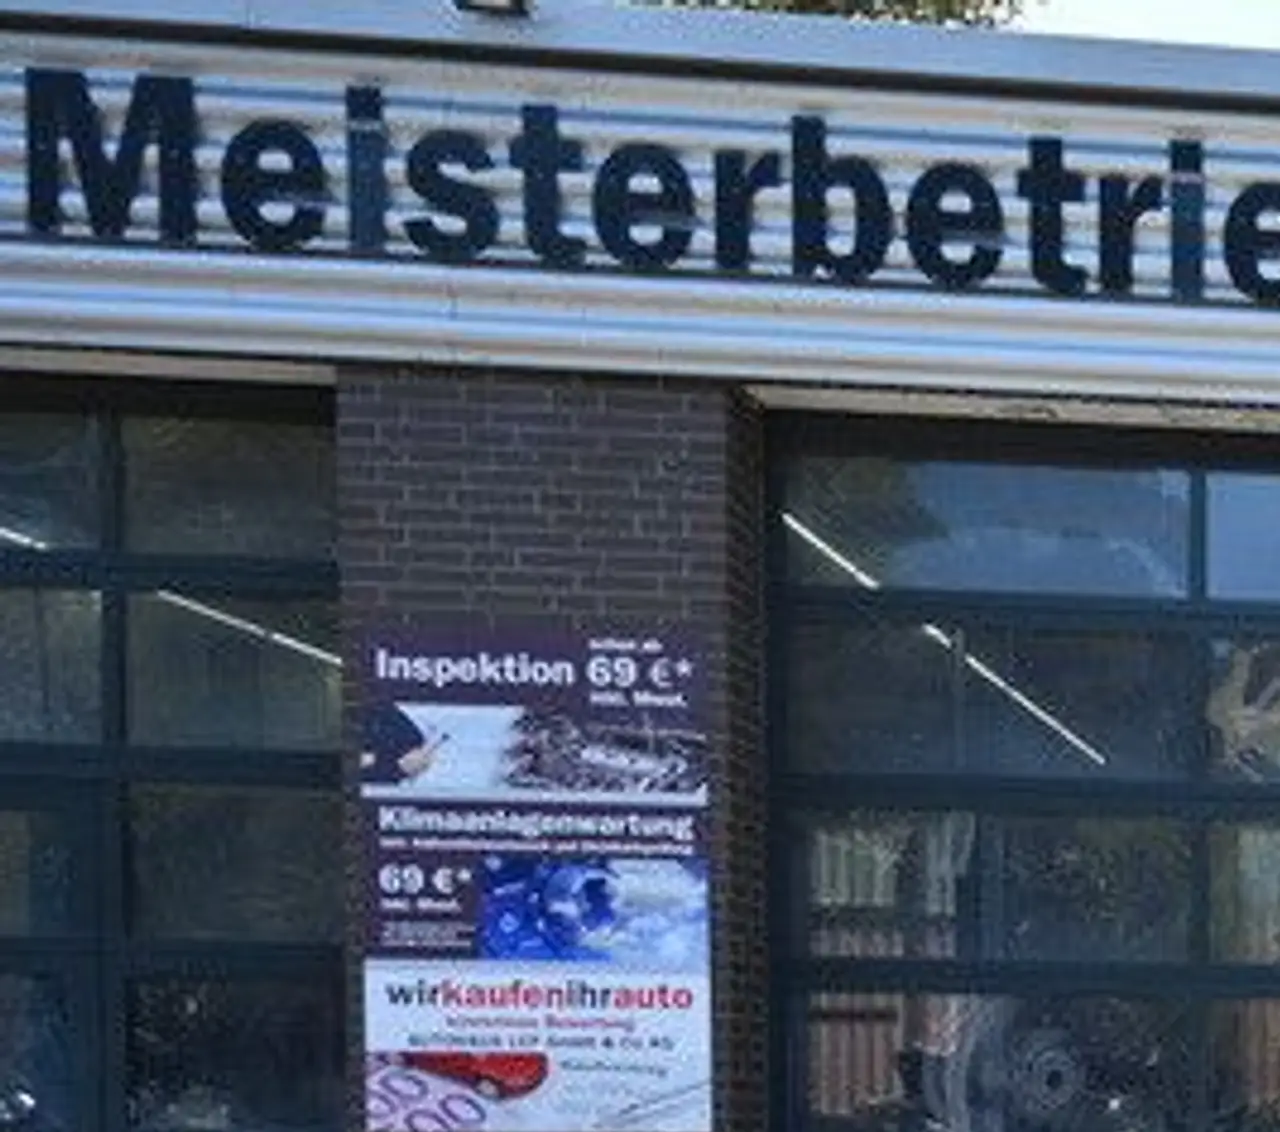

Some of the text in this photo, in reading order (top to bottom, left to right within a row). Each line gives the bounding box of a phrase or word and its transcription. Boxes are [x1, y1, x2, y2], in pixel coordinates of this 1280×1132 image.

[375, 648, 577, 688] Inspektion
[585, 655, 638, 688] 69
[377, 805, 695, 842] Klimaanlagenwartung
[378, 864, 424, 895] 69
[384, 978, 694, 1010] wirkaufenihrauto
